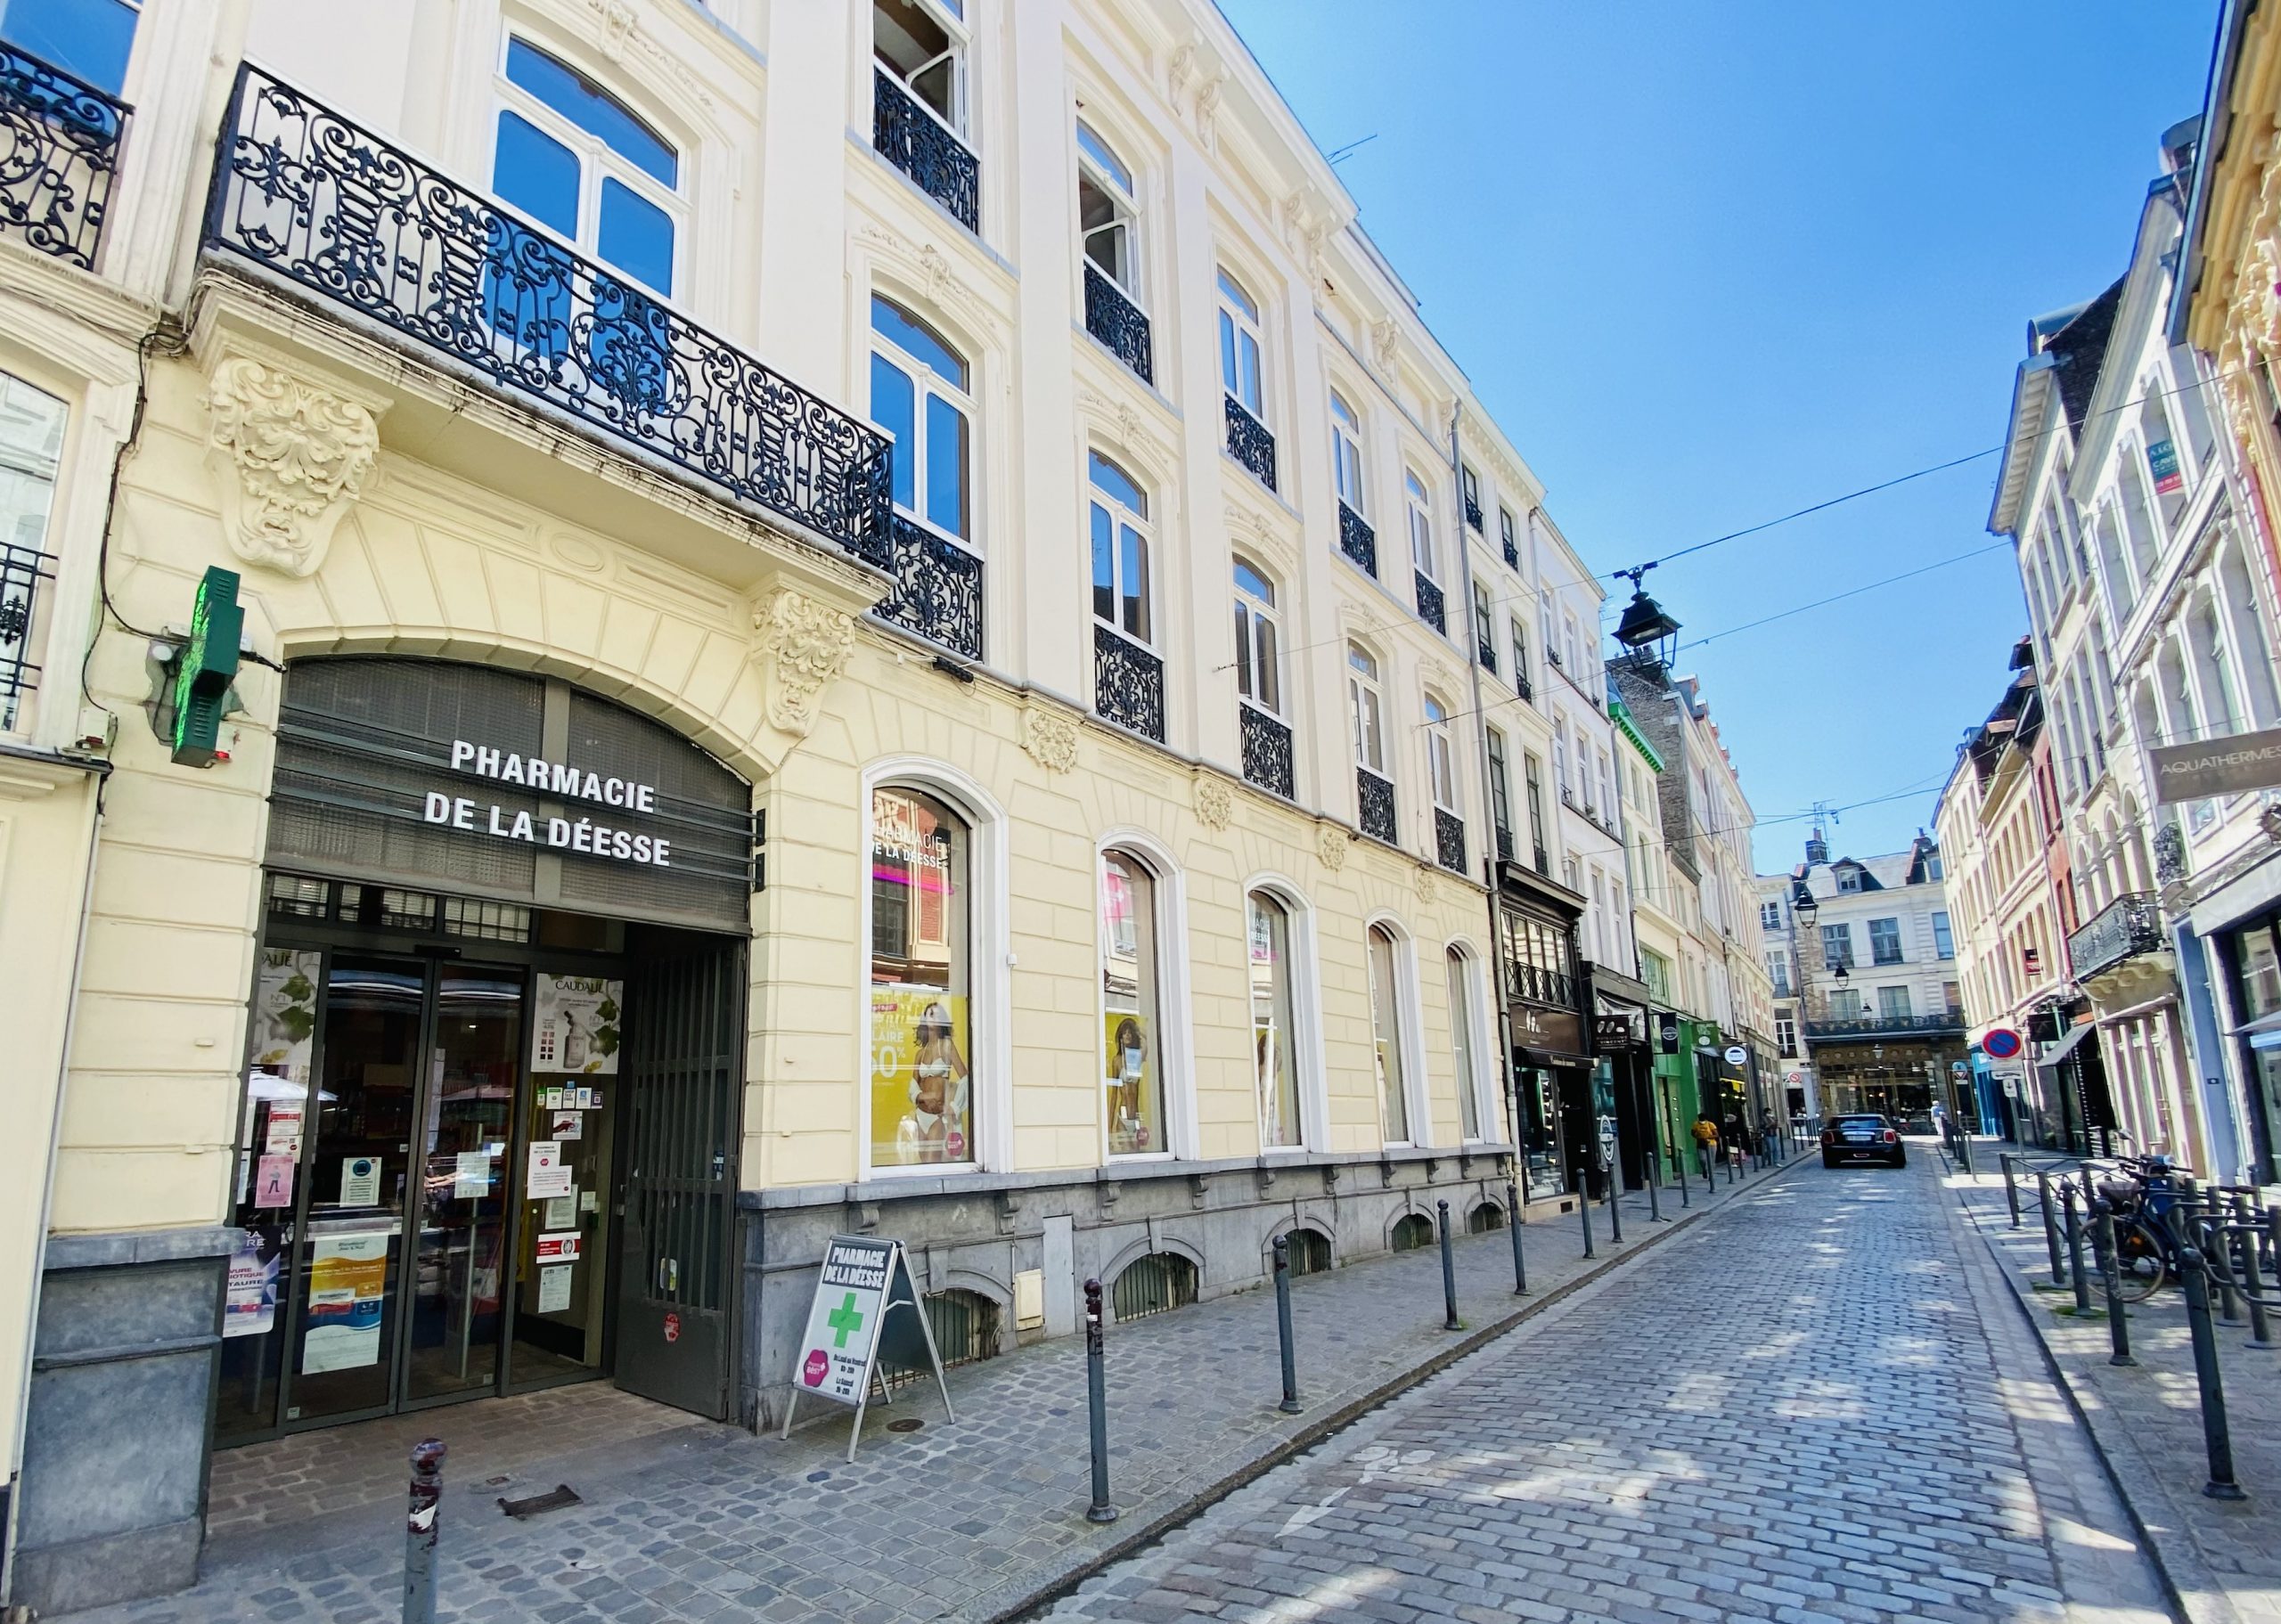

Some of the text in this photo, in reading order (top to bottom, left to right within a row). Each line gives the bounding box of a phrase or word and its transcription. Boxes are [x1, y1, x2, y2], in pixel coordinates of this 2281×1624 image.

[450, 739, 655, 813] PHARMACIE
[423, 791, 670, 867] DE LA DÉESSE
[824, 1265, 886, 1288] DE LA DÉESSE
[831, 1246, 886, 1268] PHARMACIE
